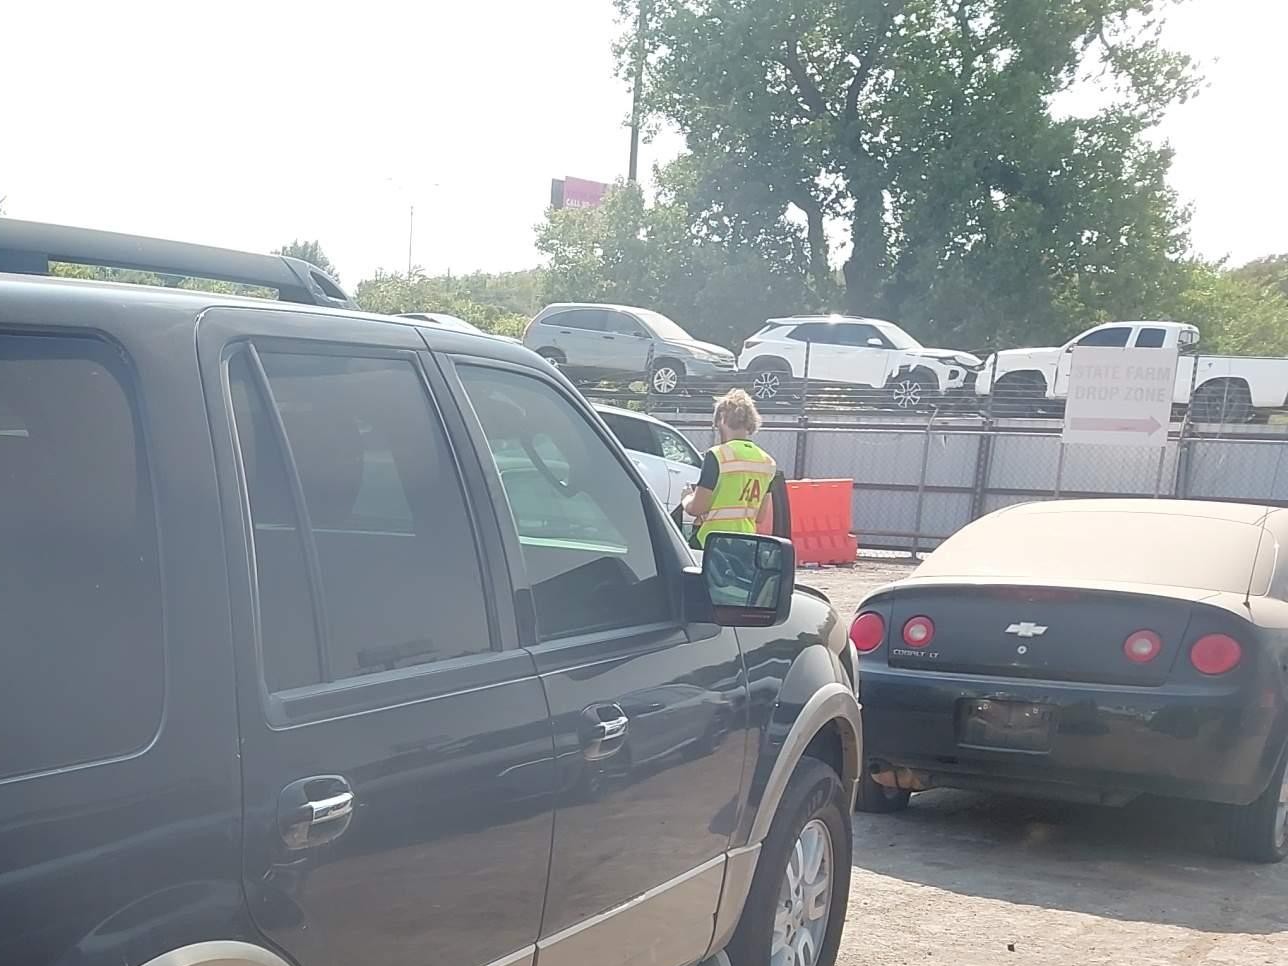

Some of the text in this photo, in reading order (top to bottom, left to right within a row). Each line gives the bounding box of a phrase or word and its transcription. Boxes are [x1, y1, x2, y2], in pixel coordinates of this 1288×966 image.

[1075, 365, 1171, 381] STATE FARM
[1075, 385, 1166, 402] DROP ZONE
